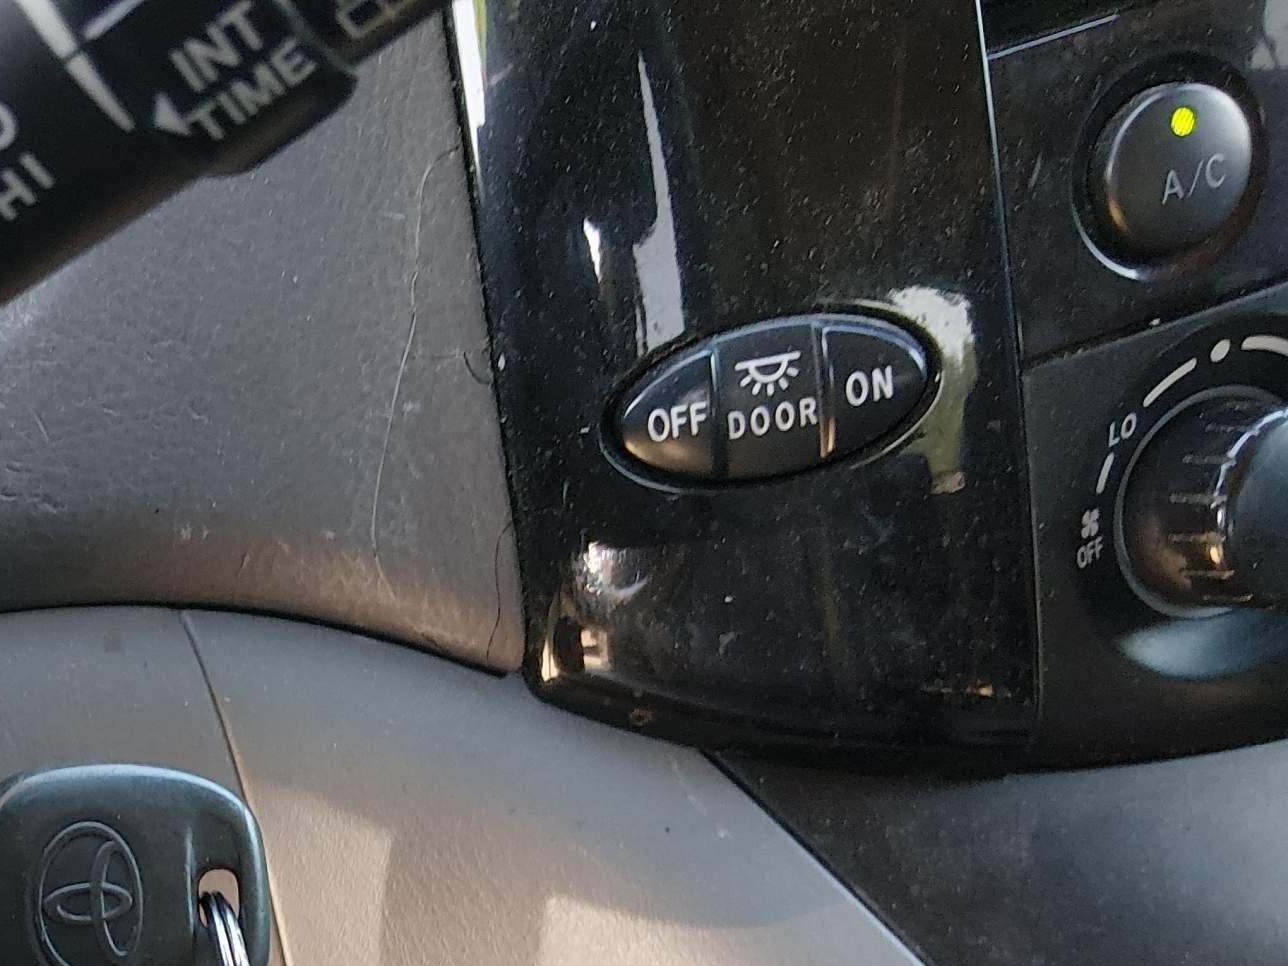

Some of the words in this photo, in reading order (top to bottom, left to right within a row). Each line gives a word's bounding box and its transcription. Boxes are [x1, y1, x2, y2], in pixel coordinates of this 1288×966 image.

[169, 5, 268, 93] INT
[185, 36, 317, 142] TIME
[1161, 153, 1227, 205] A/C
[845, 365, 895, 407] ON
[647, 401, 708, 442] OFF
[727, 397, 818, 440] DOOR
[1107, 411, 1138, 448] LO
[1077, 538, 1104, 569] OFF
